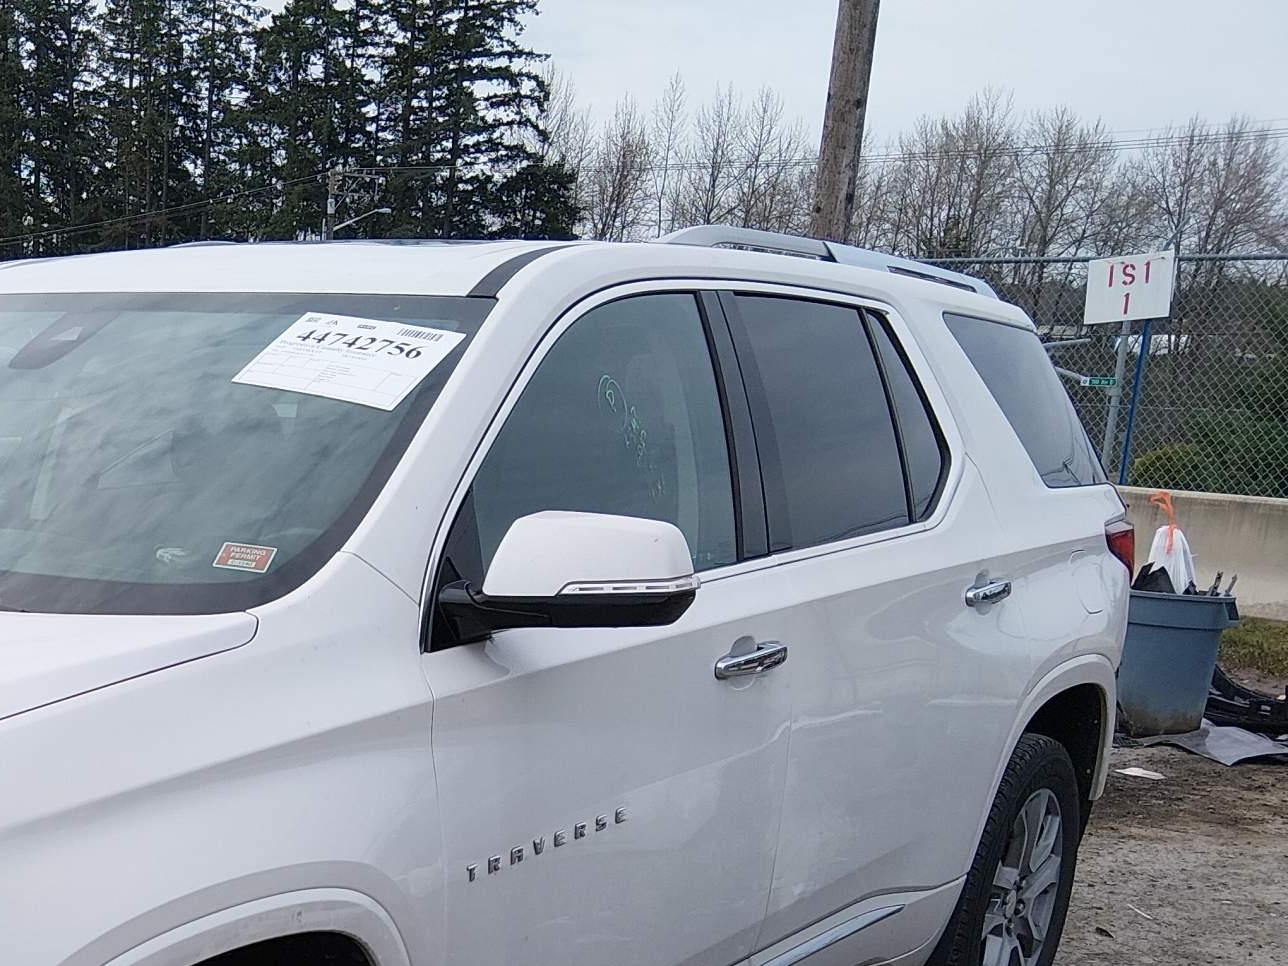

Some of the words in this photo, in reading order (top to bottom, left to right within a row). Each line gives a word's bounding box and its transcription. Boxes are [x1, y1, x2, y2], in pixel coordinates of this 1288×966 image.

[1123, 292, 1130, 315] 1
[296, 329, 424, 360] 44742756
[230, 546, 266, 556] PARKING
[466, 806, 628, 882] TRAVERSE
